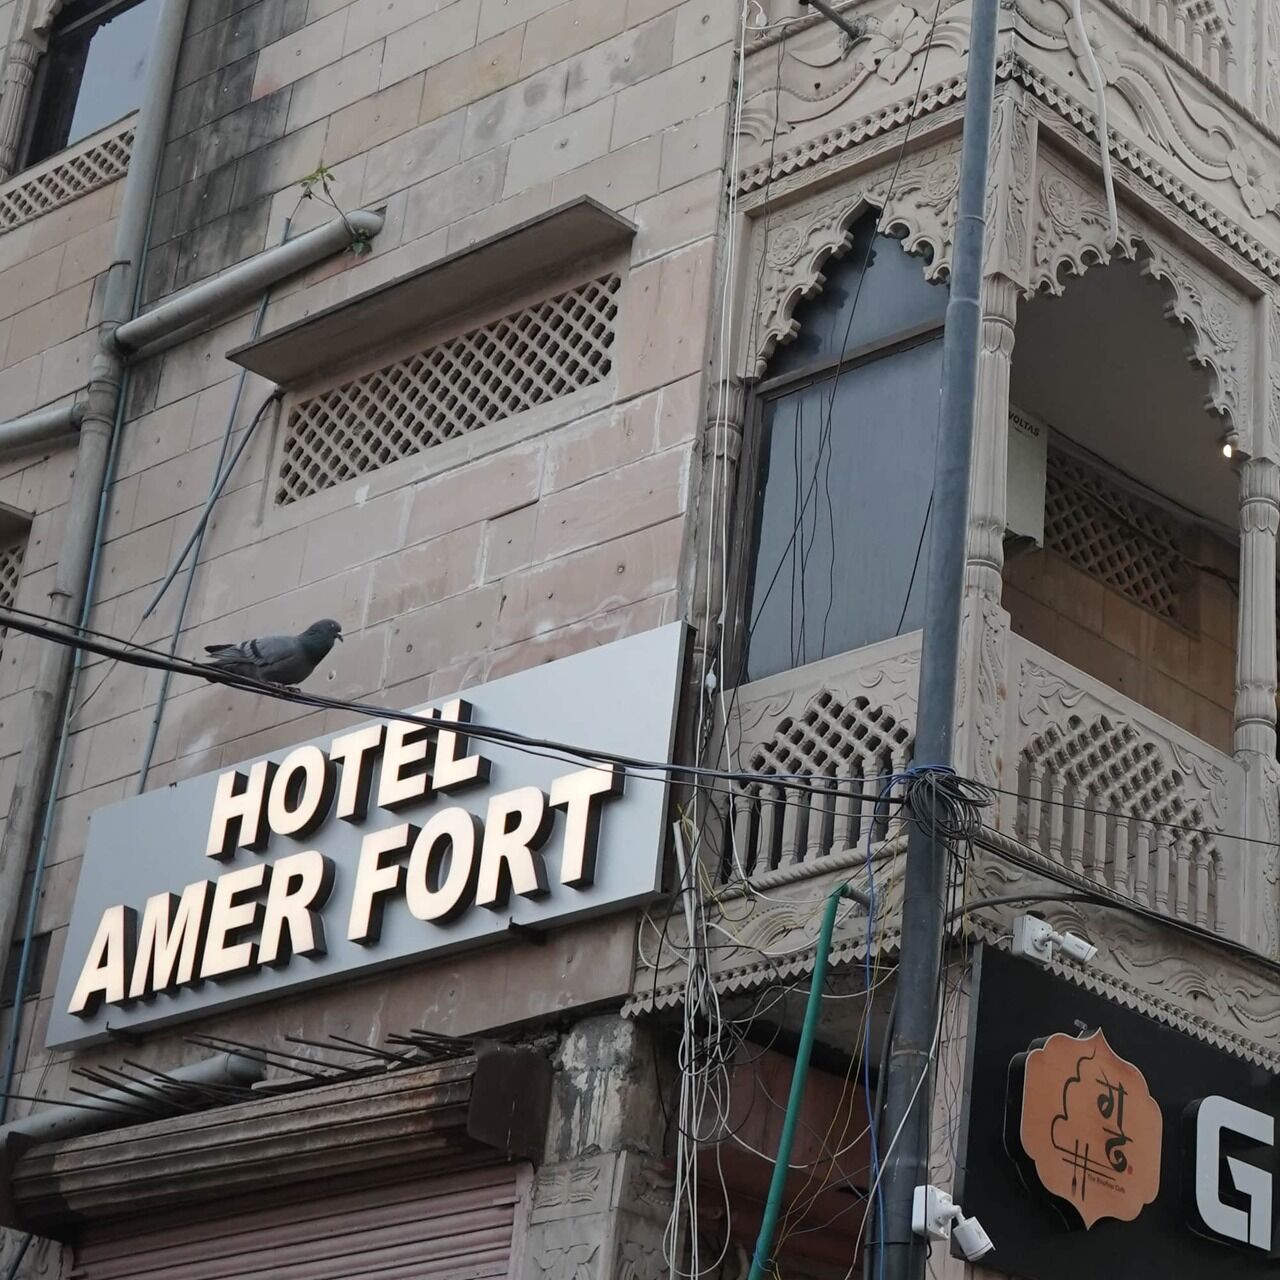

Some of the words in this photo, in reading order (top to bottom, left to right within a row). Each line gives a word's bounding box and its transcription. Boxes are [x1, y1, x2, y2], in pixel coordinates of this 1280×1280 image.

[206, 698, 487, 859] HOTEL
[67, 850, 331, 1018] AMER
[348, 763, 620, 945] FORT
